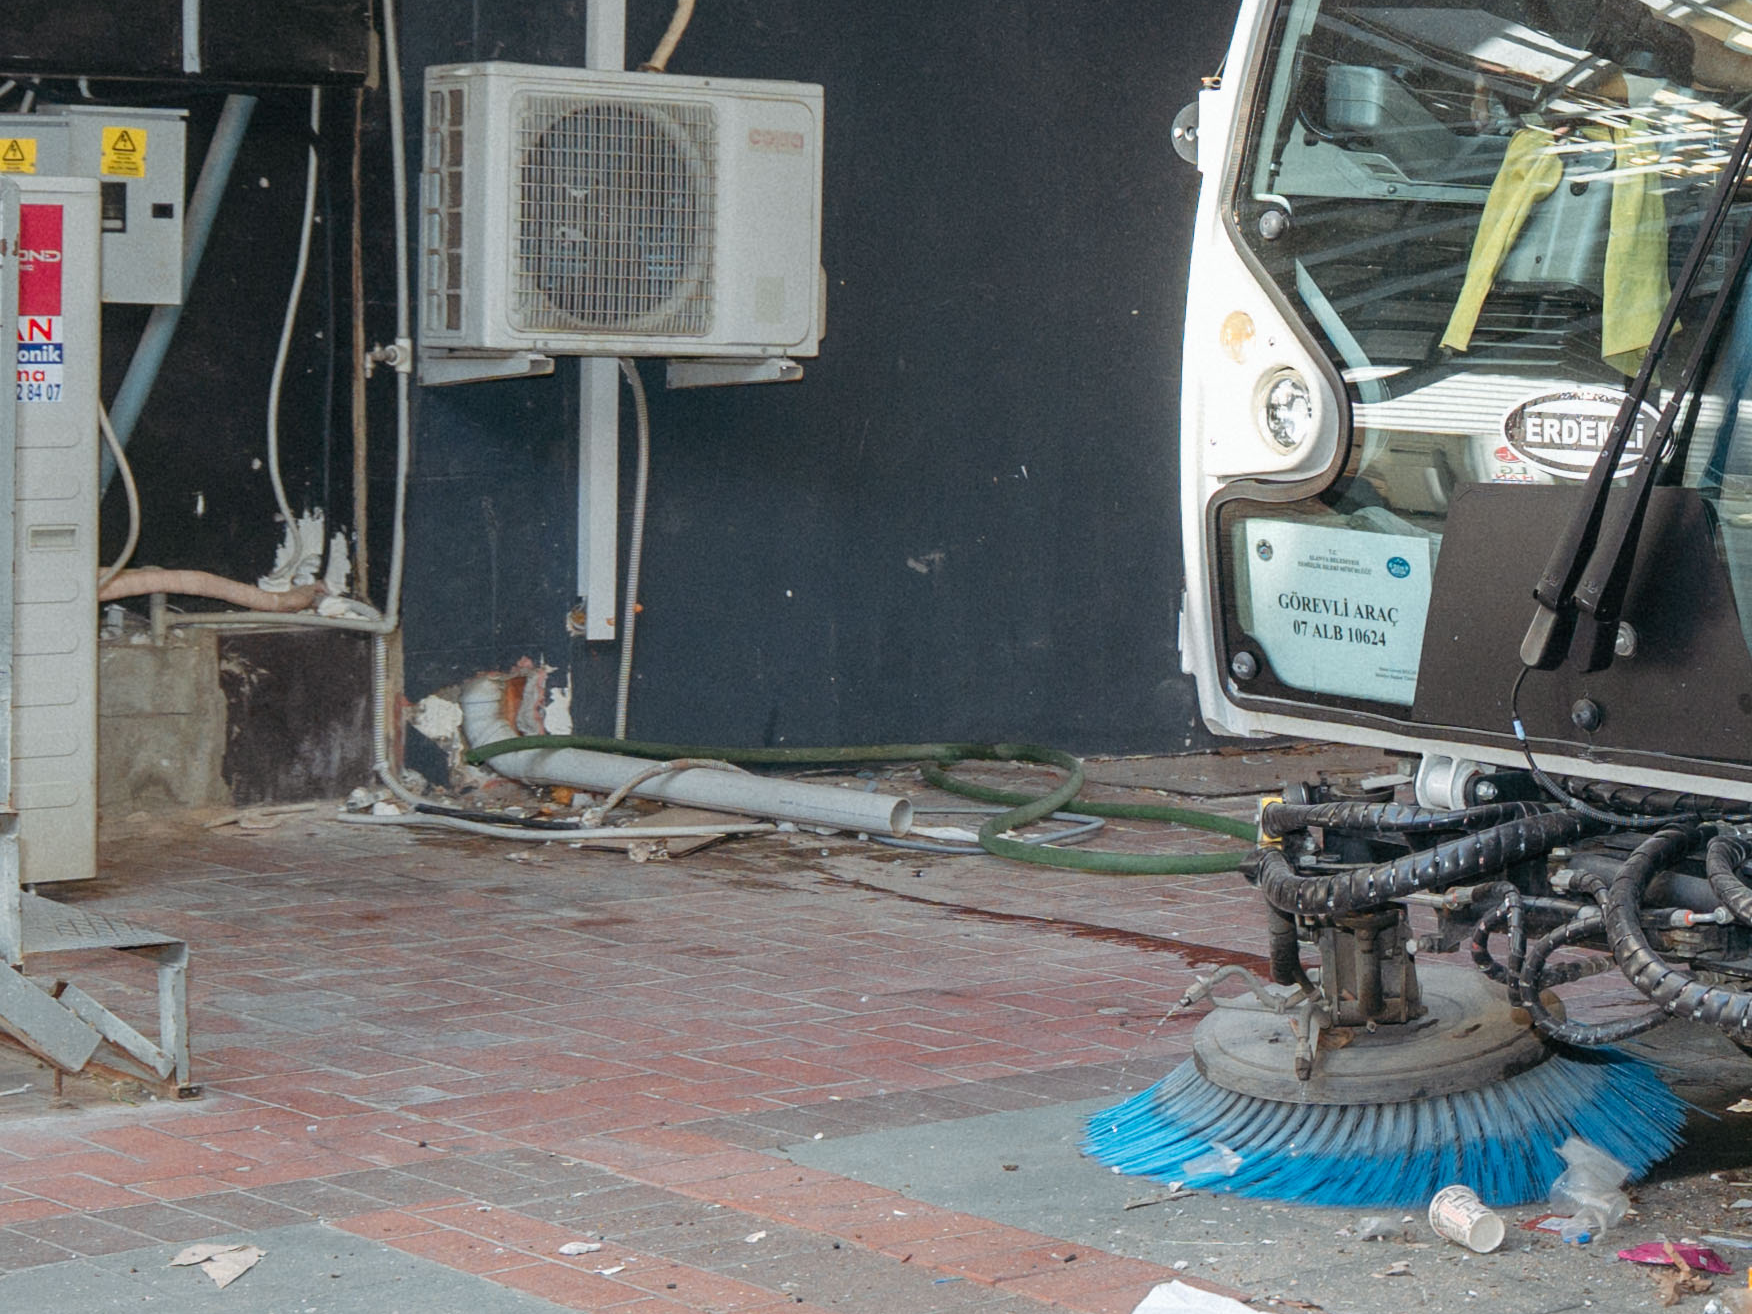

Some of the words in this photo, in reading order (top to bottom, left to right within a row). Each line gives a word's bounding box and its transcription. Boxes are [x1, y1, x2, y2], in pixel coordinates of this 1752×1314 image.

[1278, 591, 1349, 617] GÖREVLİ
[1353, 604, 1399, 627] ARAÇ
[1293, 620, 1308, 636] 07
[1312, 623, 1343, 641] ALB
[1347, 626, 1386, 647] 10624
